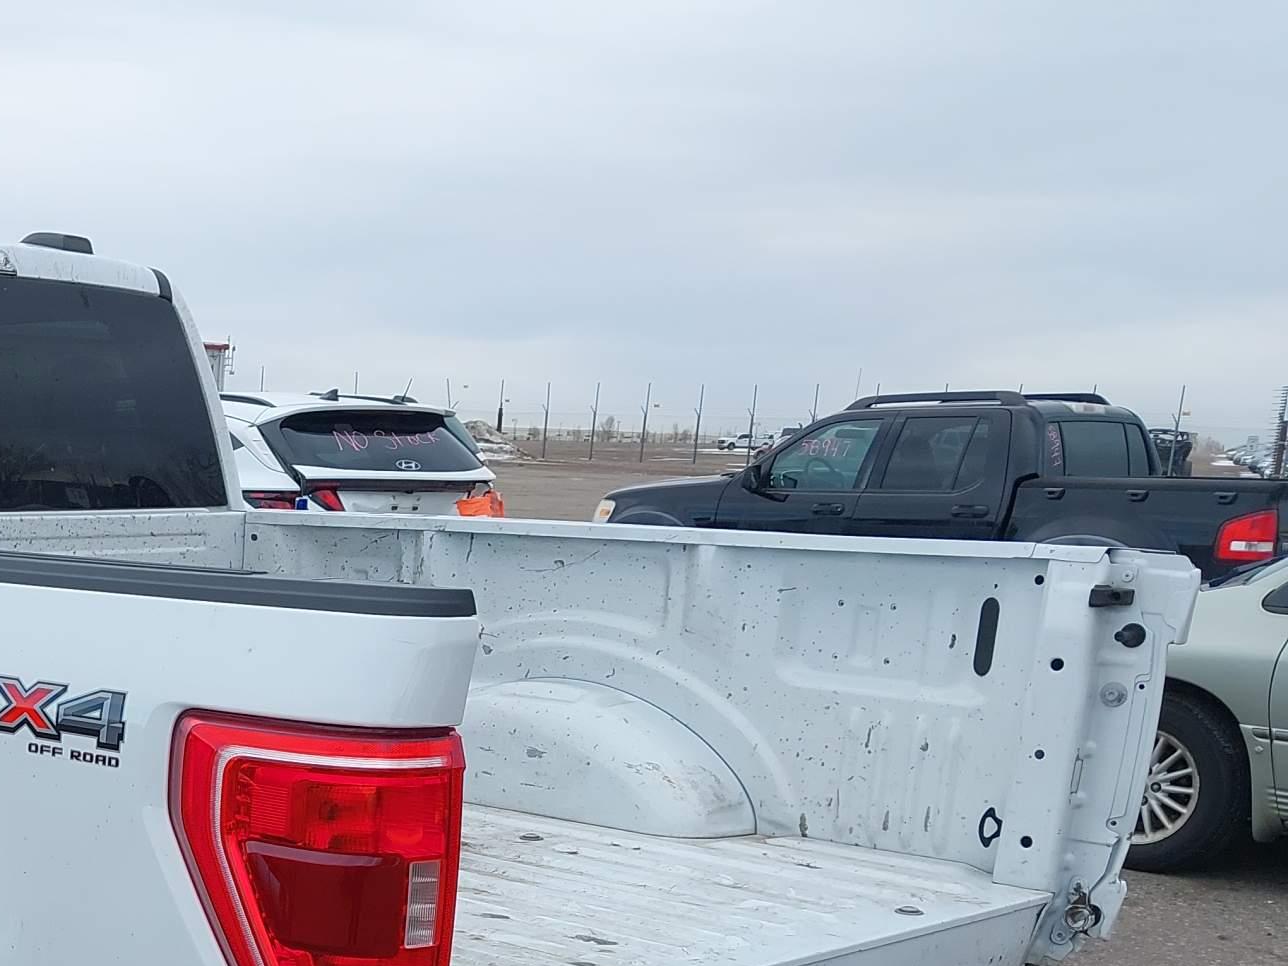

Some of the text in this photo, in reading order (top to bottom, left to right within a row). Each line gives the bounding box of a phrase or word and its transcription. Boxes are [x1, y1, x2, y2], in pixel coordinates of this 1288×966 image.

[332, 430, 368, 451] NO
[27, 742, 120, 768] OFF ROAD
